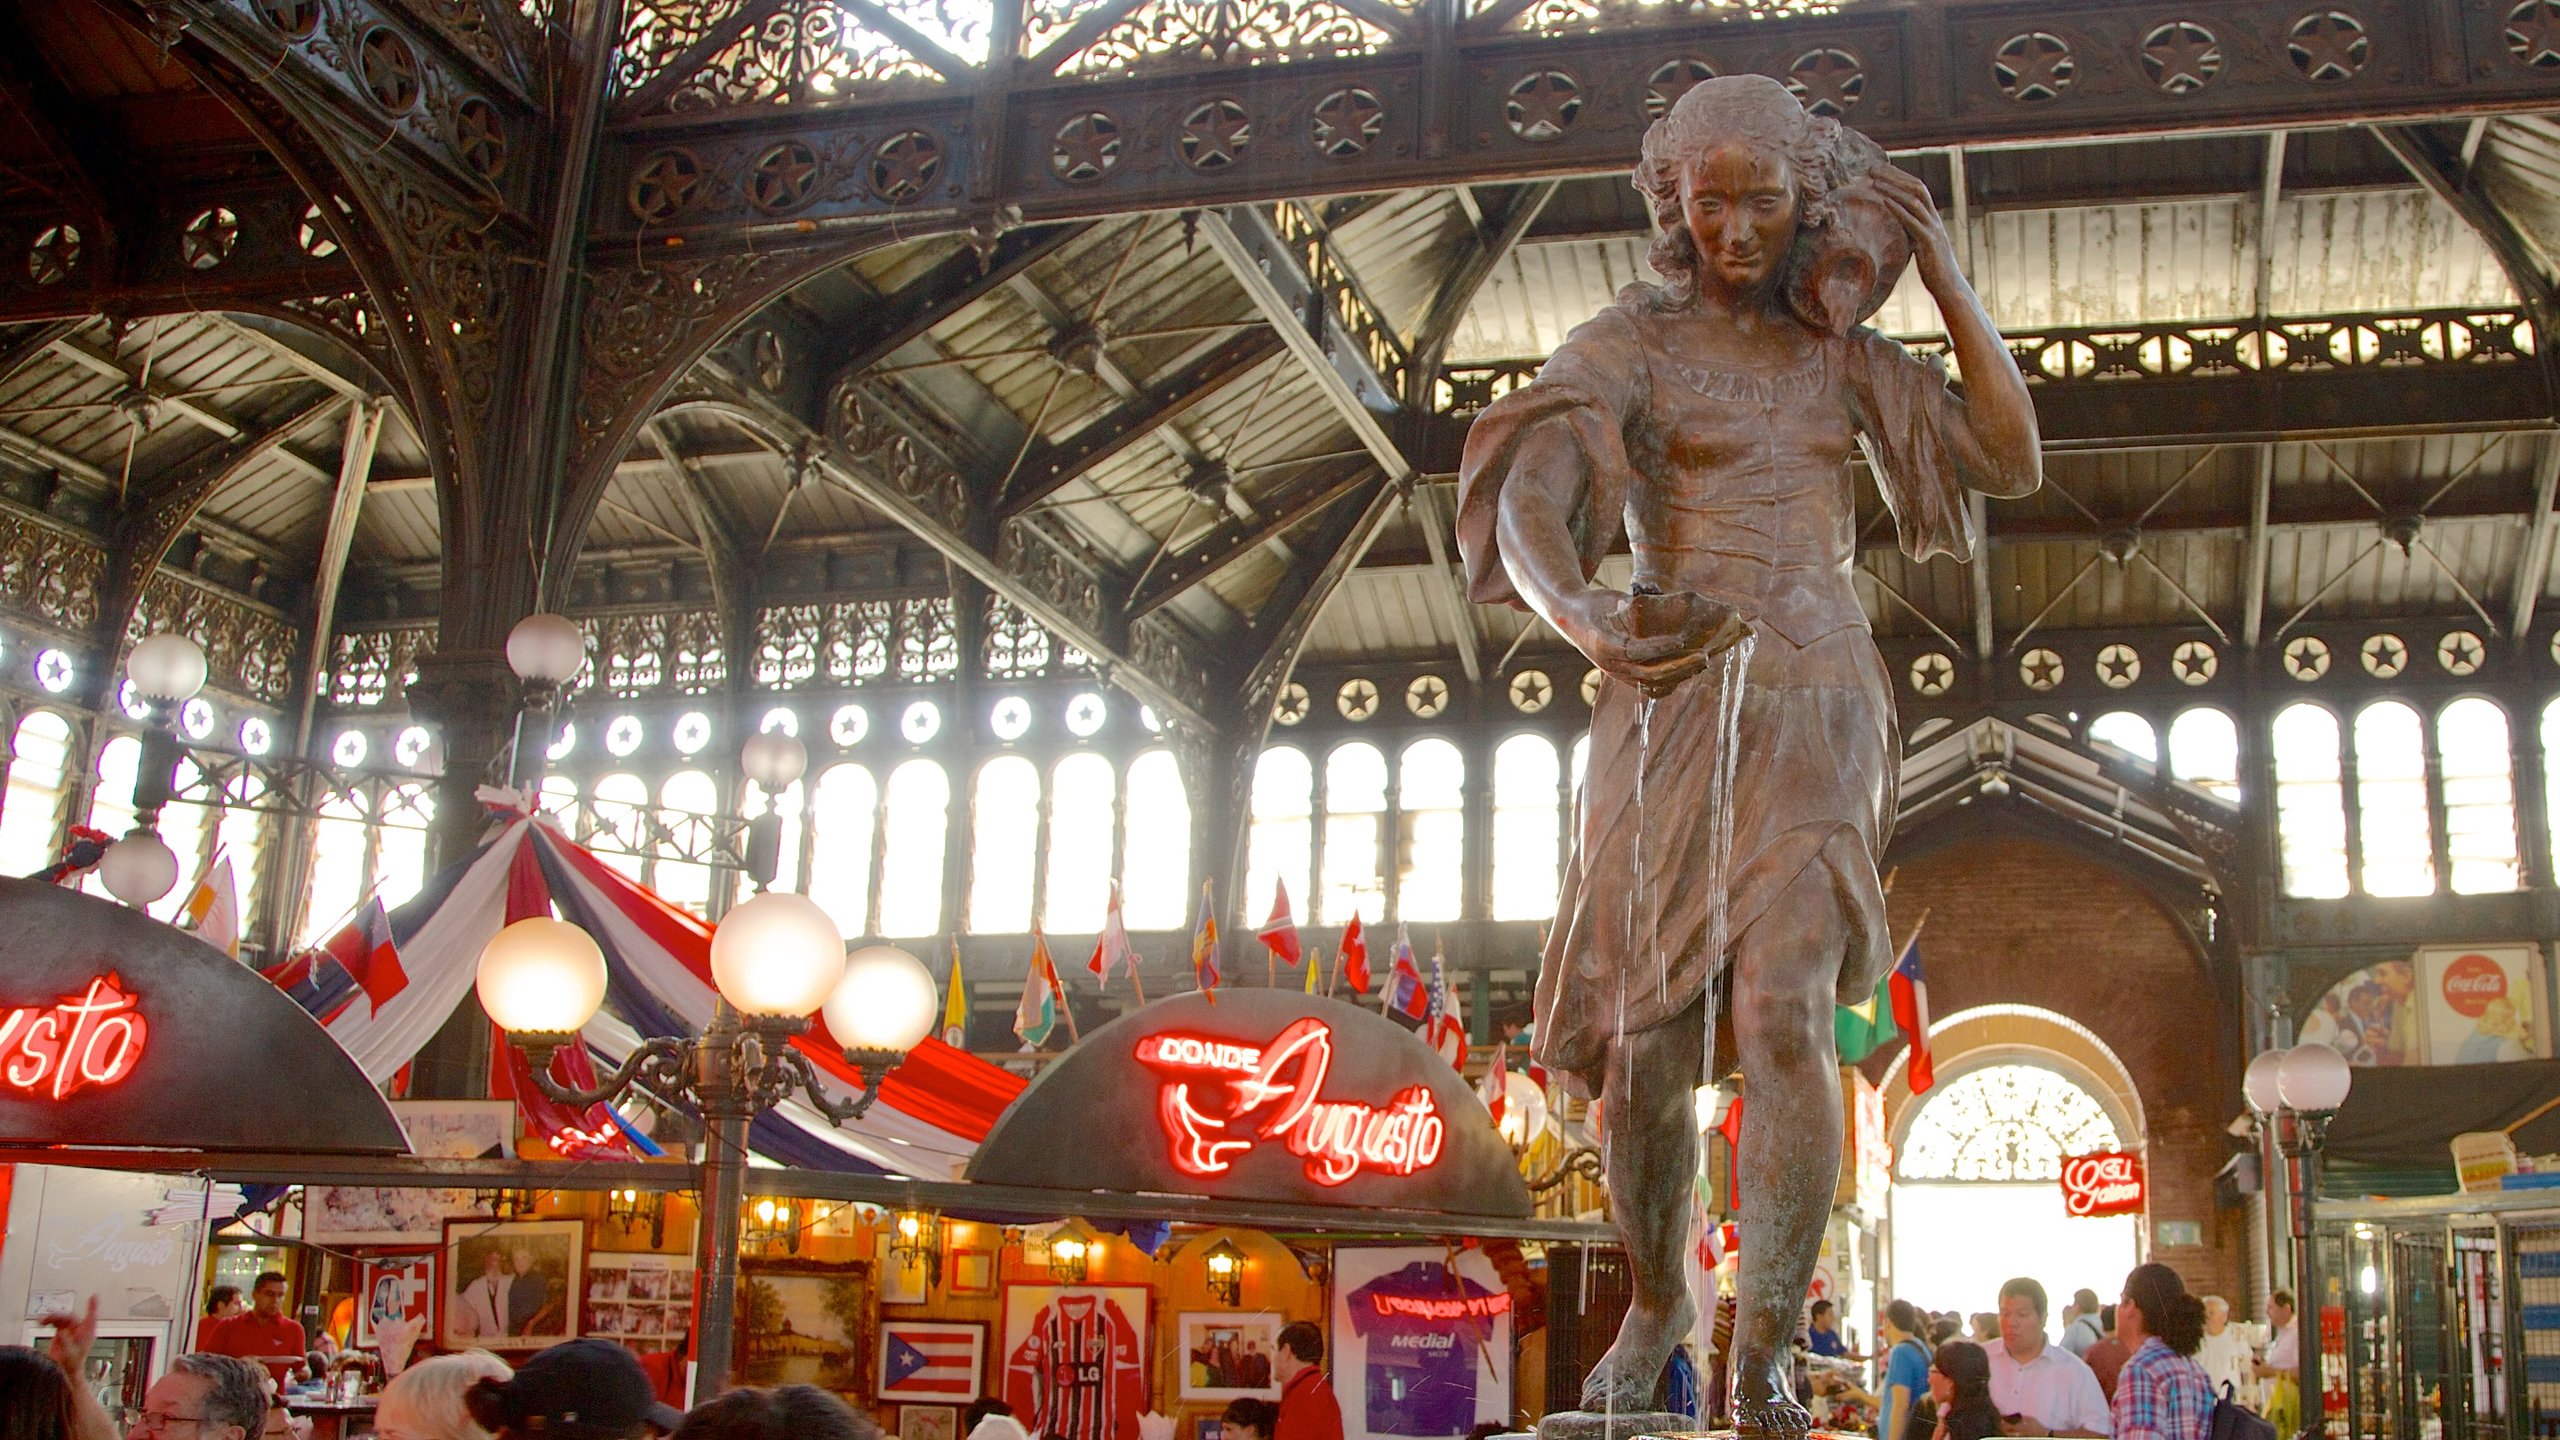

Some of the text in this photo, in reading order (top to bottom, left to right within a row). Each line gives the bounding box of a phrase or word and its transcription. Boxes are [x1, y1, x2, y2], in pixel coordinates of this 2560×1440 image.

[2447, 973, 2501, 993] Coca-Cola
[1158, 1038, 1262, 1073] DONDE
[1238, 1020, 1444, 1184] Augusto
[1078, 1366, 1101, 1382] LG
